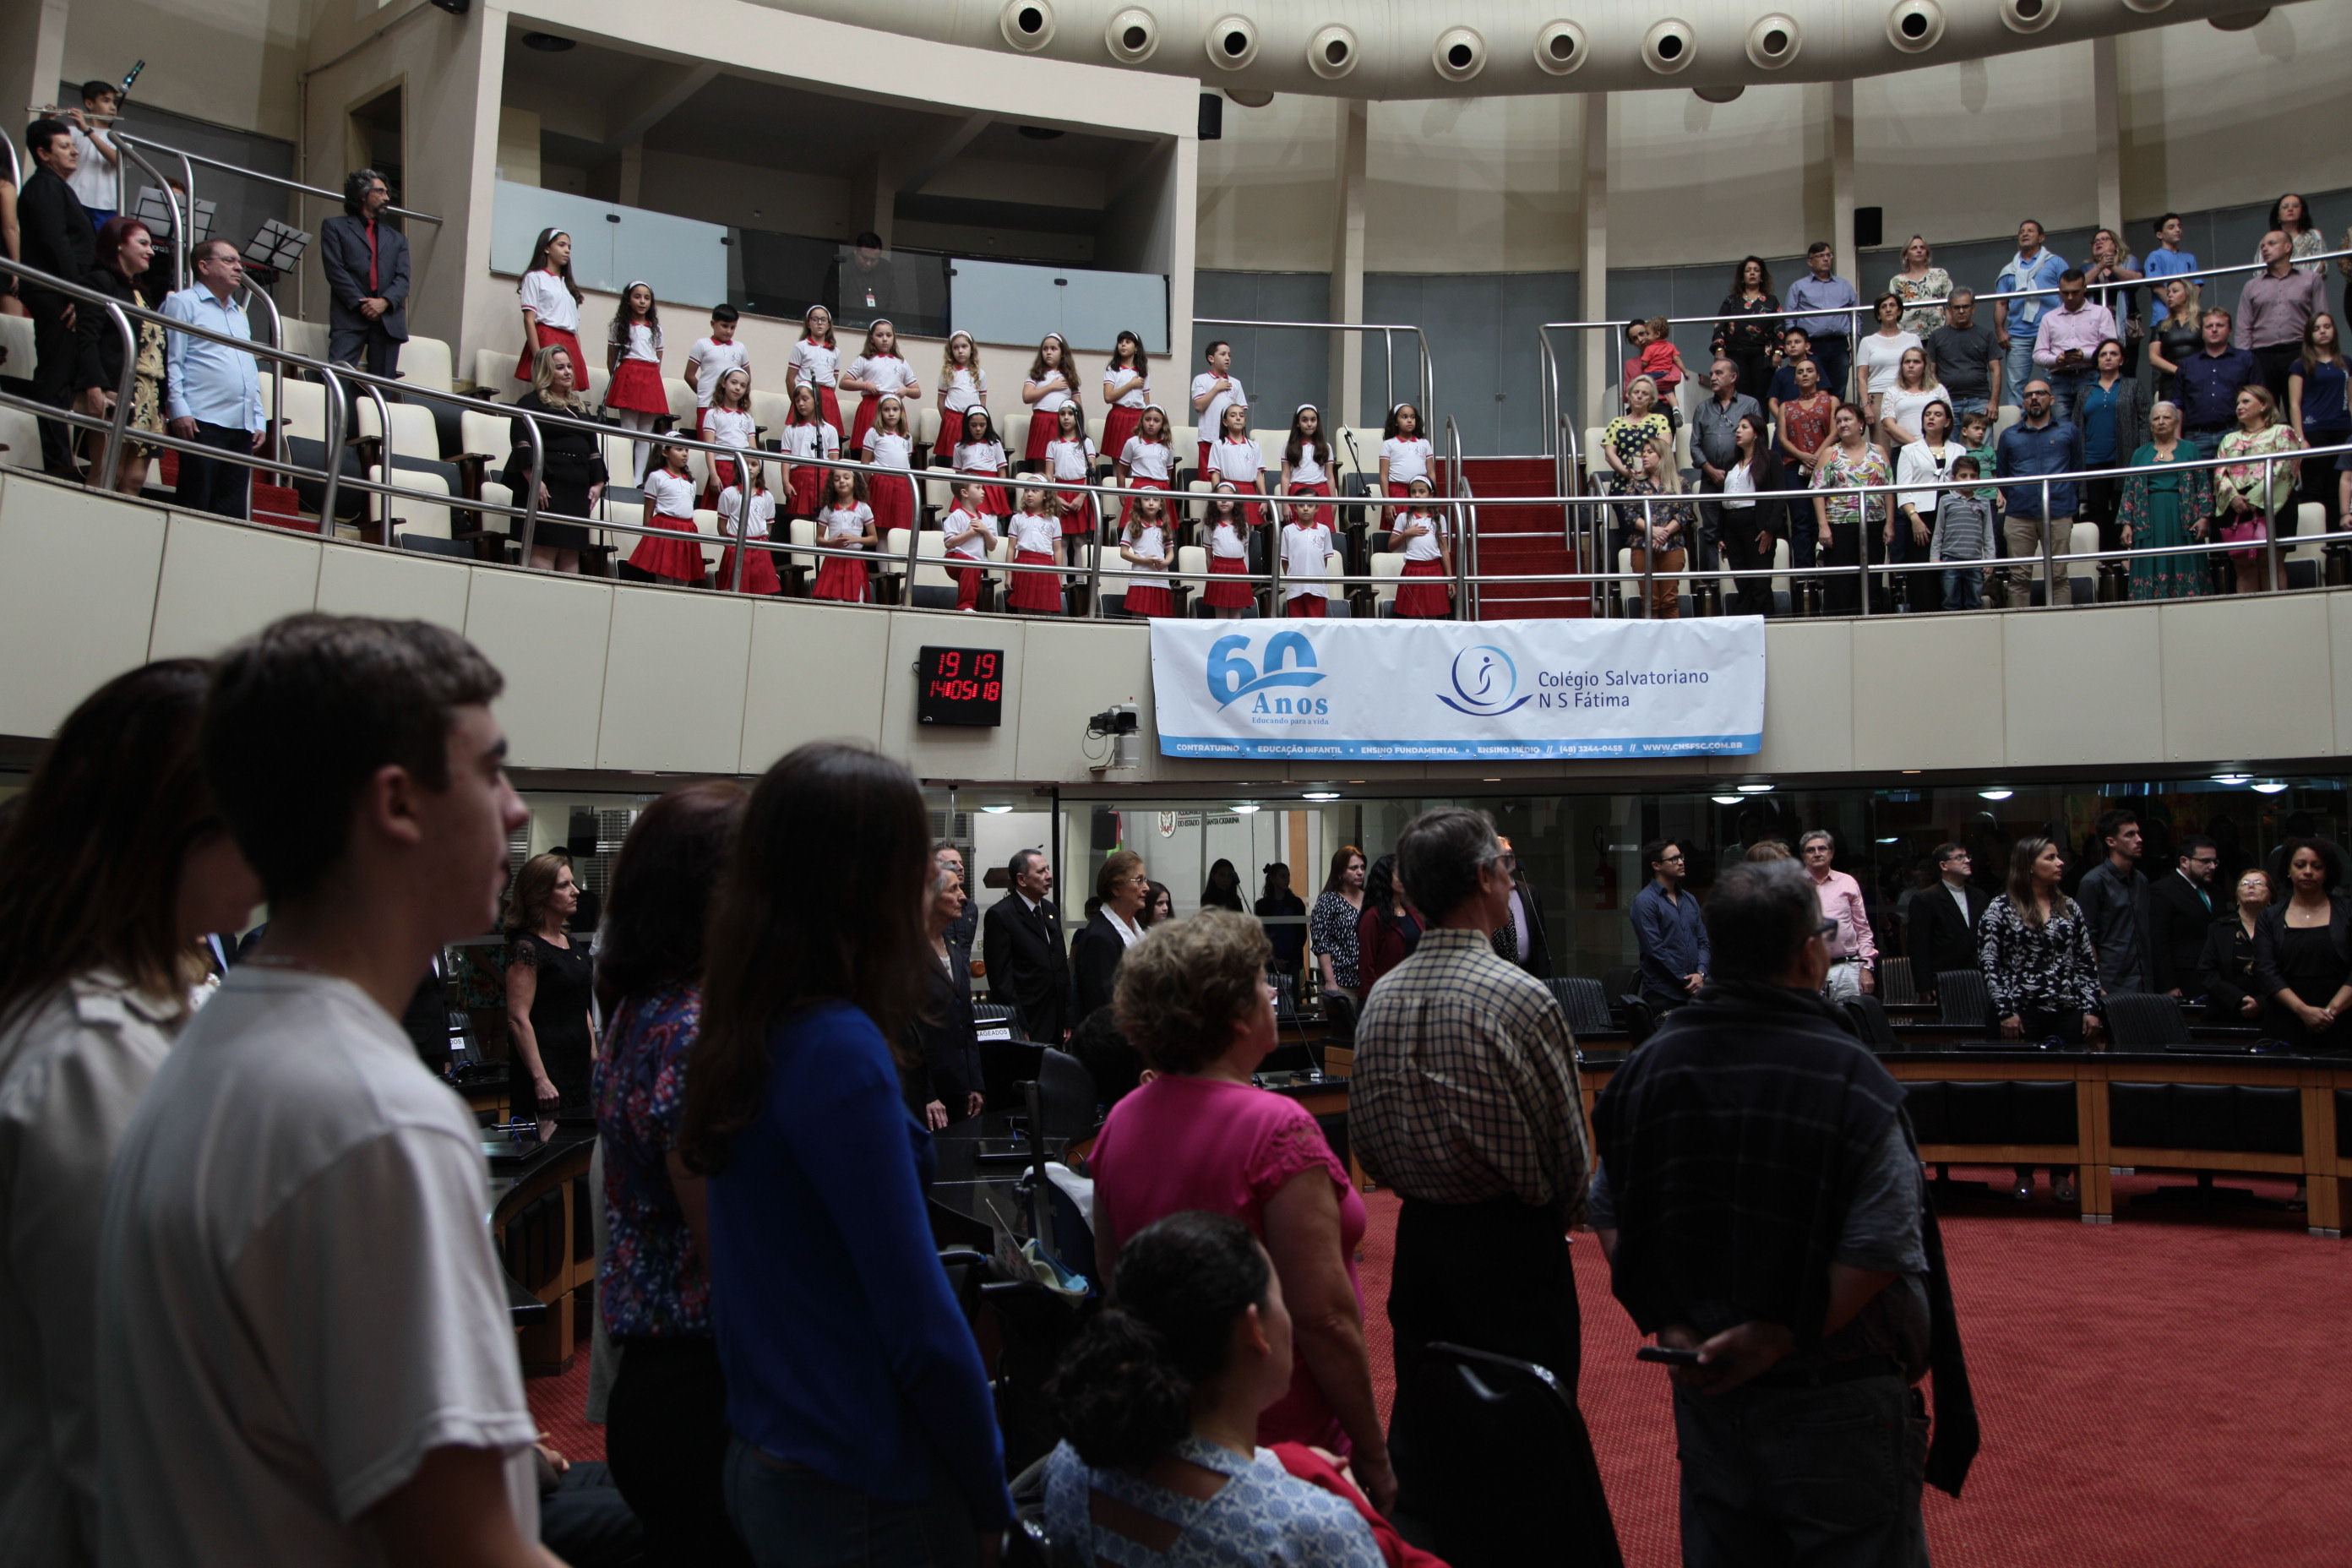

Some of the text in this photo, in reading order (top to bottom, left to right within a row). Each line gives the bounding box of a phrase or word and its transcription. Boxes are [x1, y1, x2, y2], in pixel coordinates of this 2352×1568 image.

[938, 651, 996, 678] 19 19
[1206, 630, 1318, 705] 60
[1538, 668, 1709, 691] Colégio Salvatoriano
[1251, 692, 1329, 716] Anos
[1539, 691, 1630, 708] N S Fátima
[1176, 743, 1240, 753] CONTRATURNO
[1257, 744, 1304, 755] EDUCAÇÃO
[1511, 744, 1540, 754] MÉDIO
[1560, 745, 1576, 754] (48)
[1578, 744, 1623, 753] 3244-0455
[1642, 742, 1743, 751] WWW.CNSFSC.COM.BR
[1218, 817, 1240, 825] CATARINA
